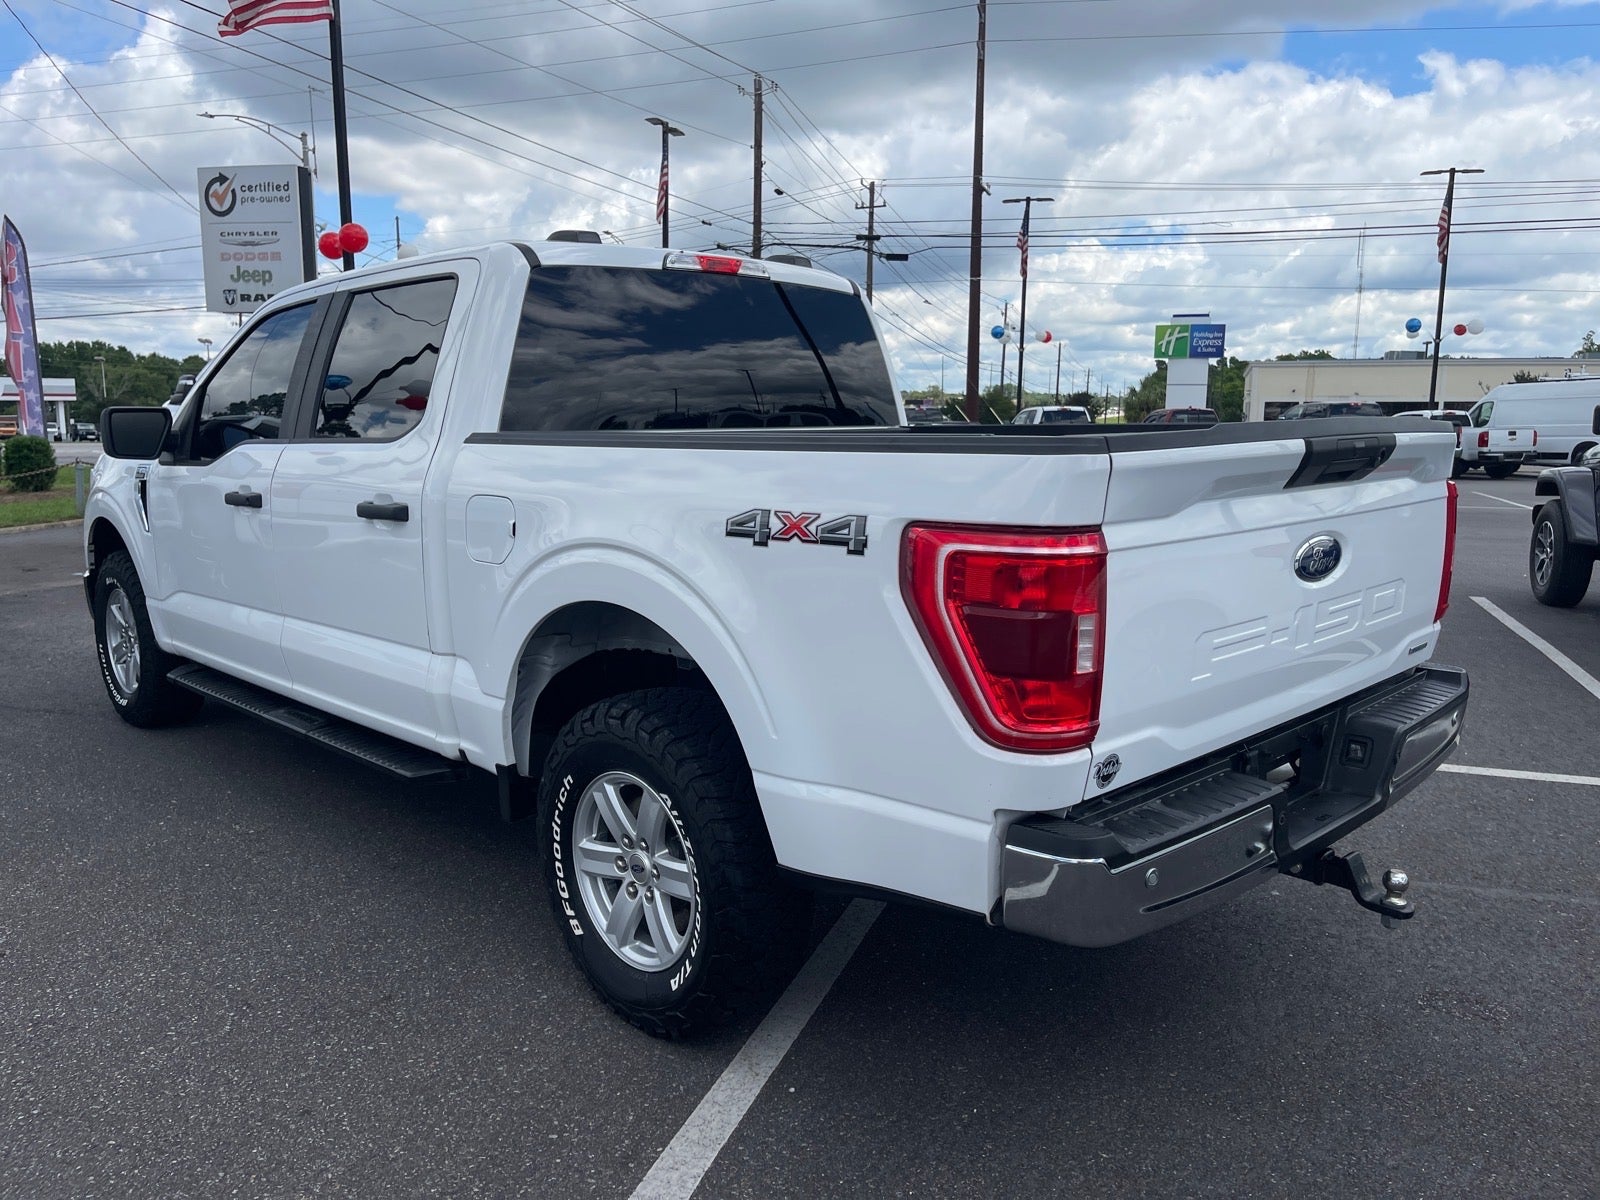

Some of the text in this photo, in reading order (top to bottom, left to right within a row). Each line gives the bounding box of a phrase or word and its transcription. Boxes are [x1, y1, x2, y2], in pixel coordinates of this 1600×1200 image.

[240, 181, 290, 193] certified
[240, 194, 291, 206] pre-owned
[220, 230, 278, 238] CHRYSLER
[220, 251, 282, 262] DODGE
[230, 265, 273, 286] Jeep
[1193, 337, 1222, 347] Express
[1190, 577, 1406, 682] F-150
[552, 774, 584, 936] BFGoodrich
